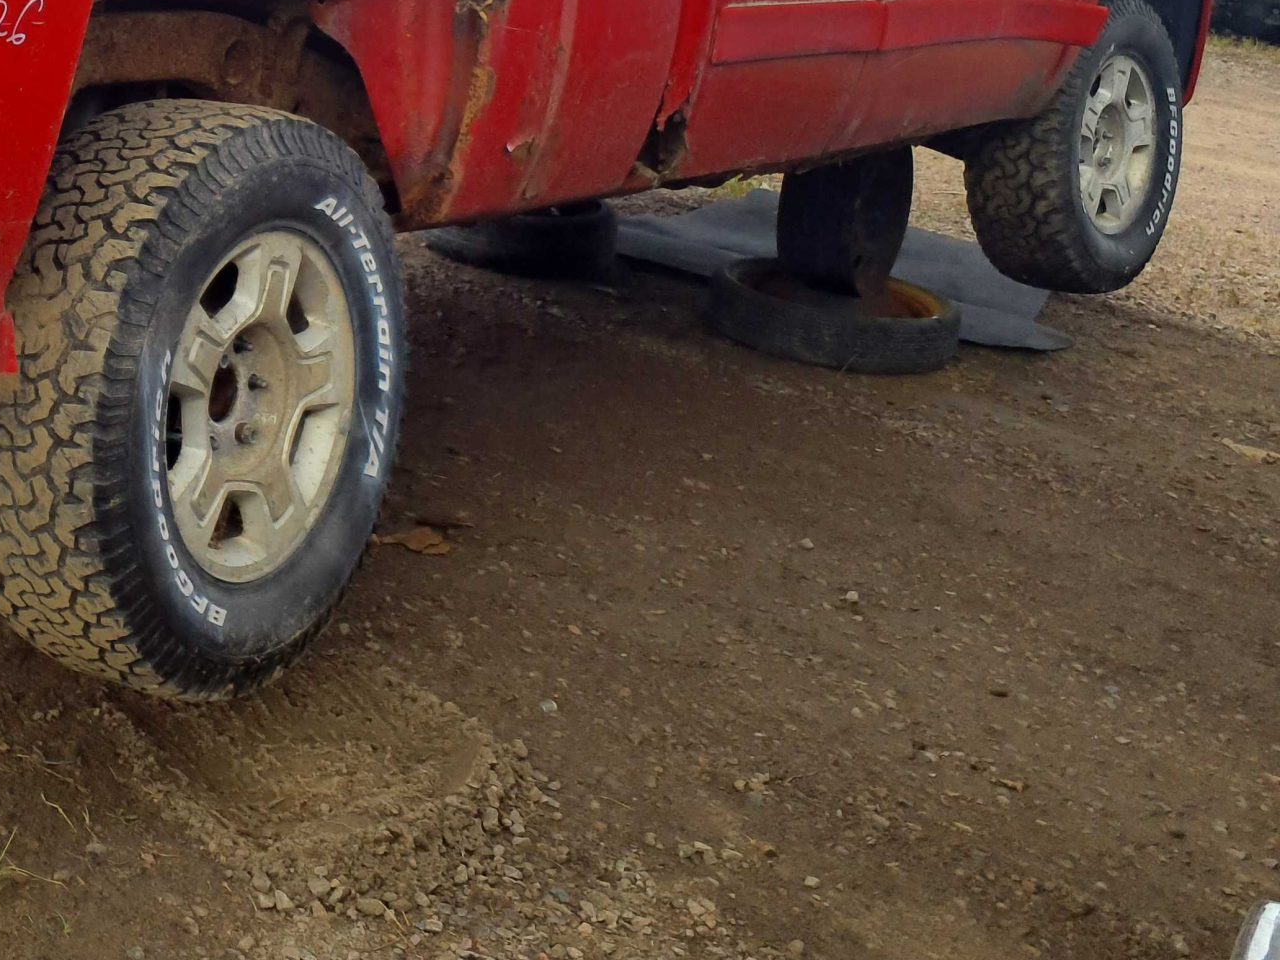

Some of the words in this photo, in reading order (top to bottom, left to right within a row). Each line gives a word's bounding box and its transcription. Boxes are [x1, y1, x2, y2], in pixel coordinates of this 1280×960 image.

[1146, 87, 1178, 237] BFGoodrich
[314, 197, 394, 392] All-Terrain
[363, 407, 391, 478] T/A
